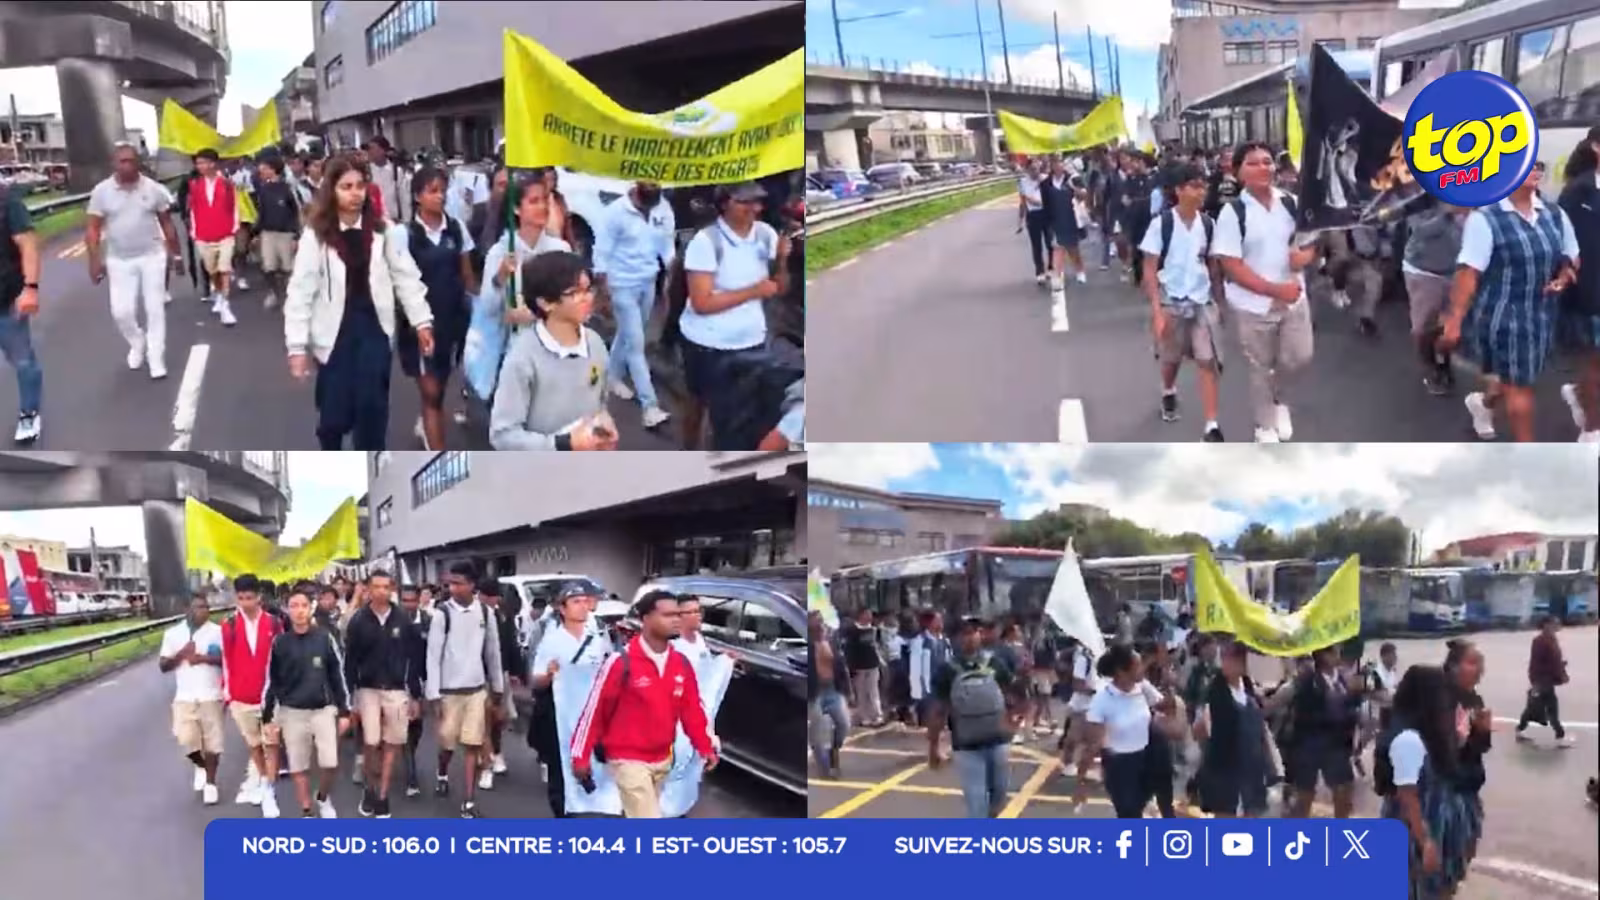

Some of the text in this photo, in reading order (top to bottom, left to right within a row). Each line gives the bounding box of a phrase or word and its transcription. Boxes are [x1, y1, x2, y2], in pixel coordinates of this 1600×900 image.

[600, 133, 619, 153] LE
[622, 131, 738, 159] HARCELEMENT
[619, 159, 670, 180] FASSE
[673, 162, 705, 181] DES
